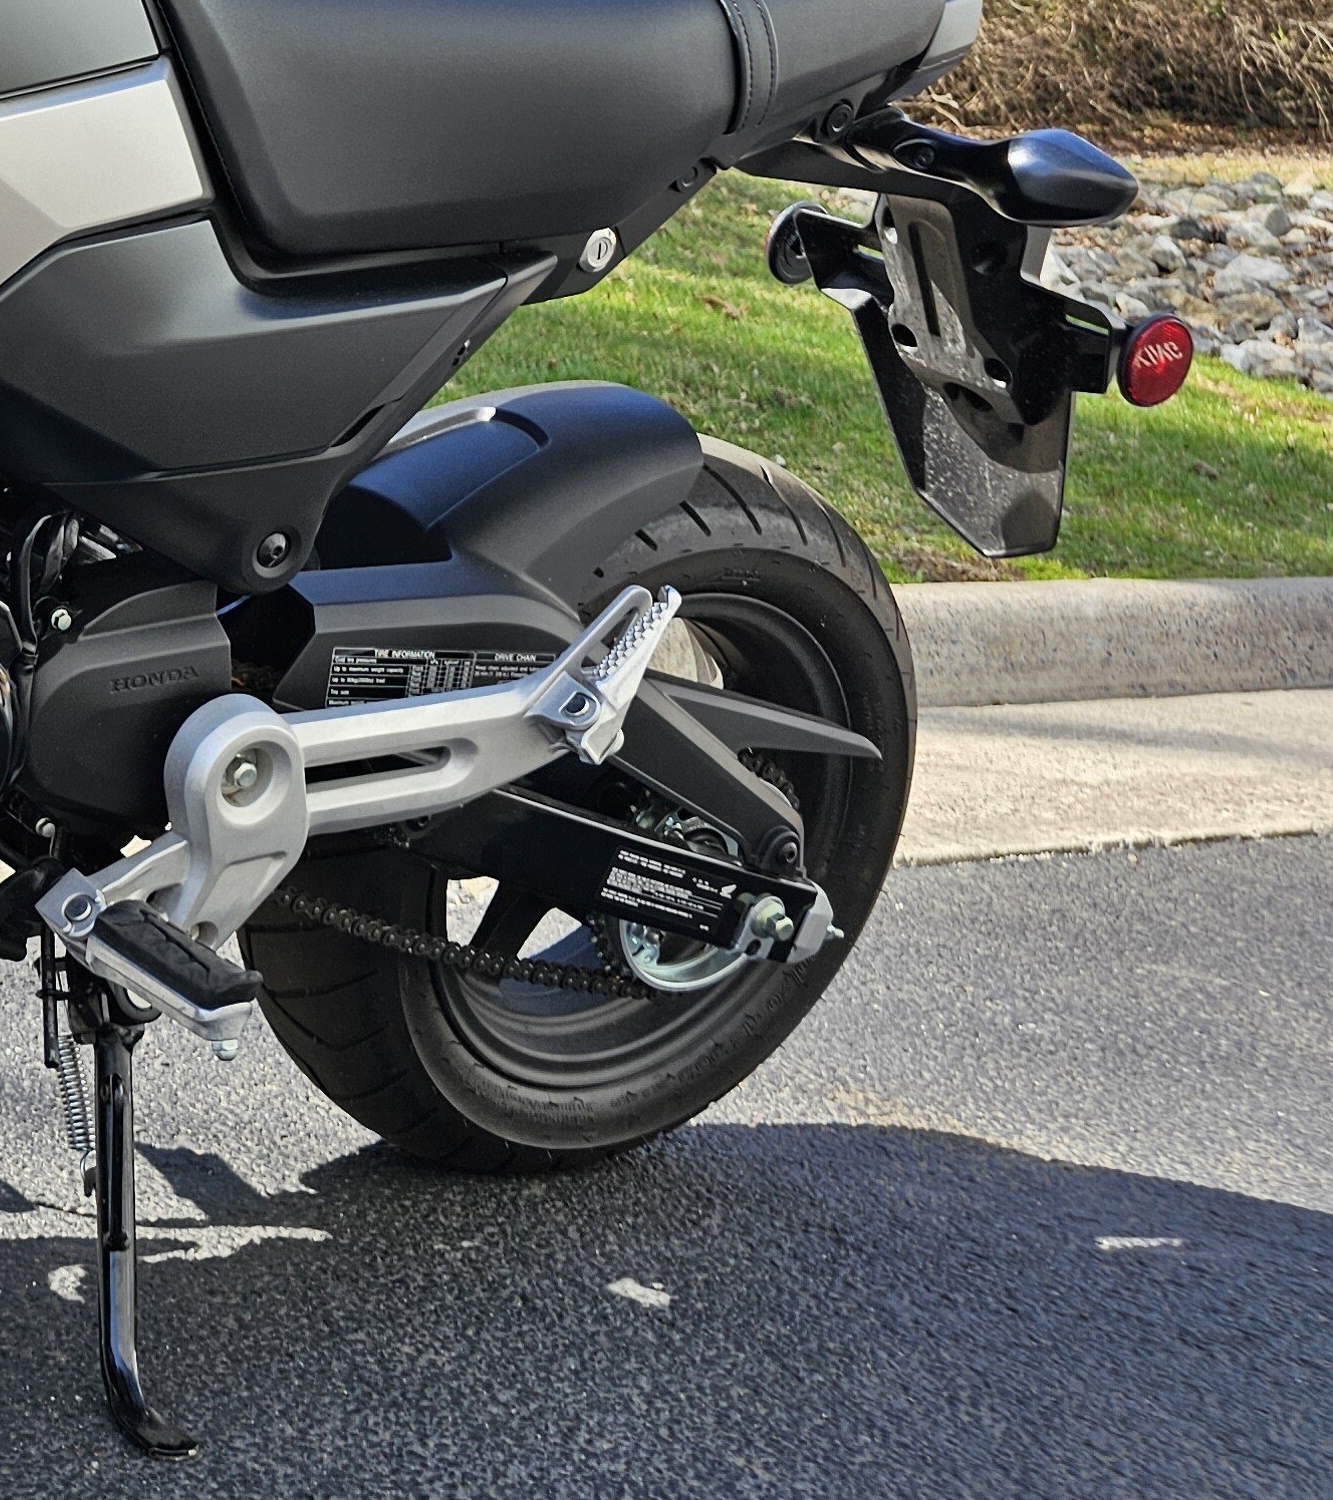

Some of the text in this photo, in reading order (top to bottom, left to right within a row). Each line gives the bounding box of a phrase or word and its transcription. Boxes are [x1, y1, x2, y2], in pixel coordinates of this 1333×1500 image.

[373, 649, 435, 658] TIRE INFORMATION
[494, 653, 536, 662] DRIVE CHAIN
[109, 666, 199, 693] HONDA
